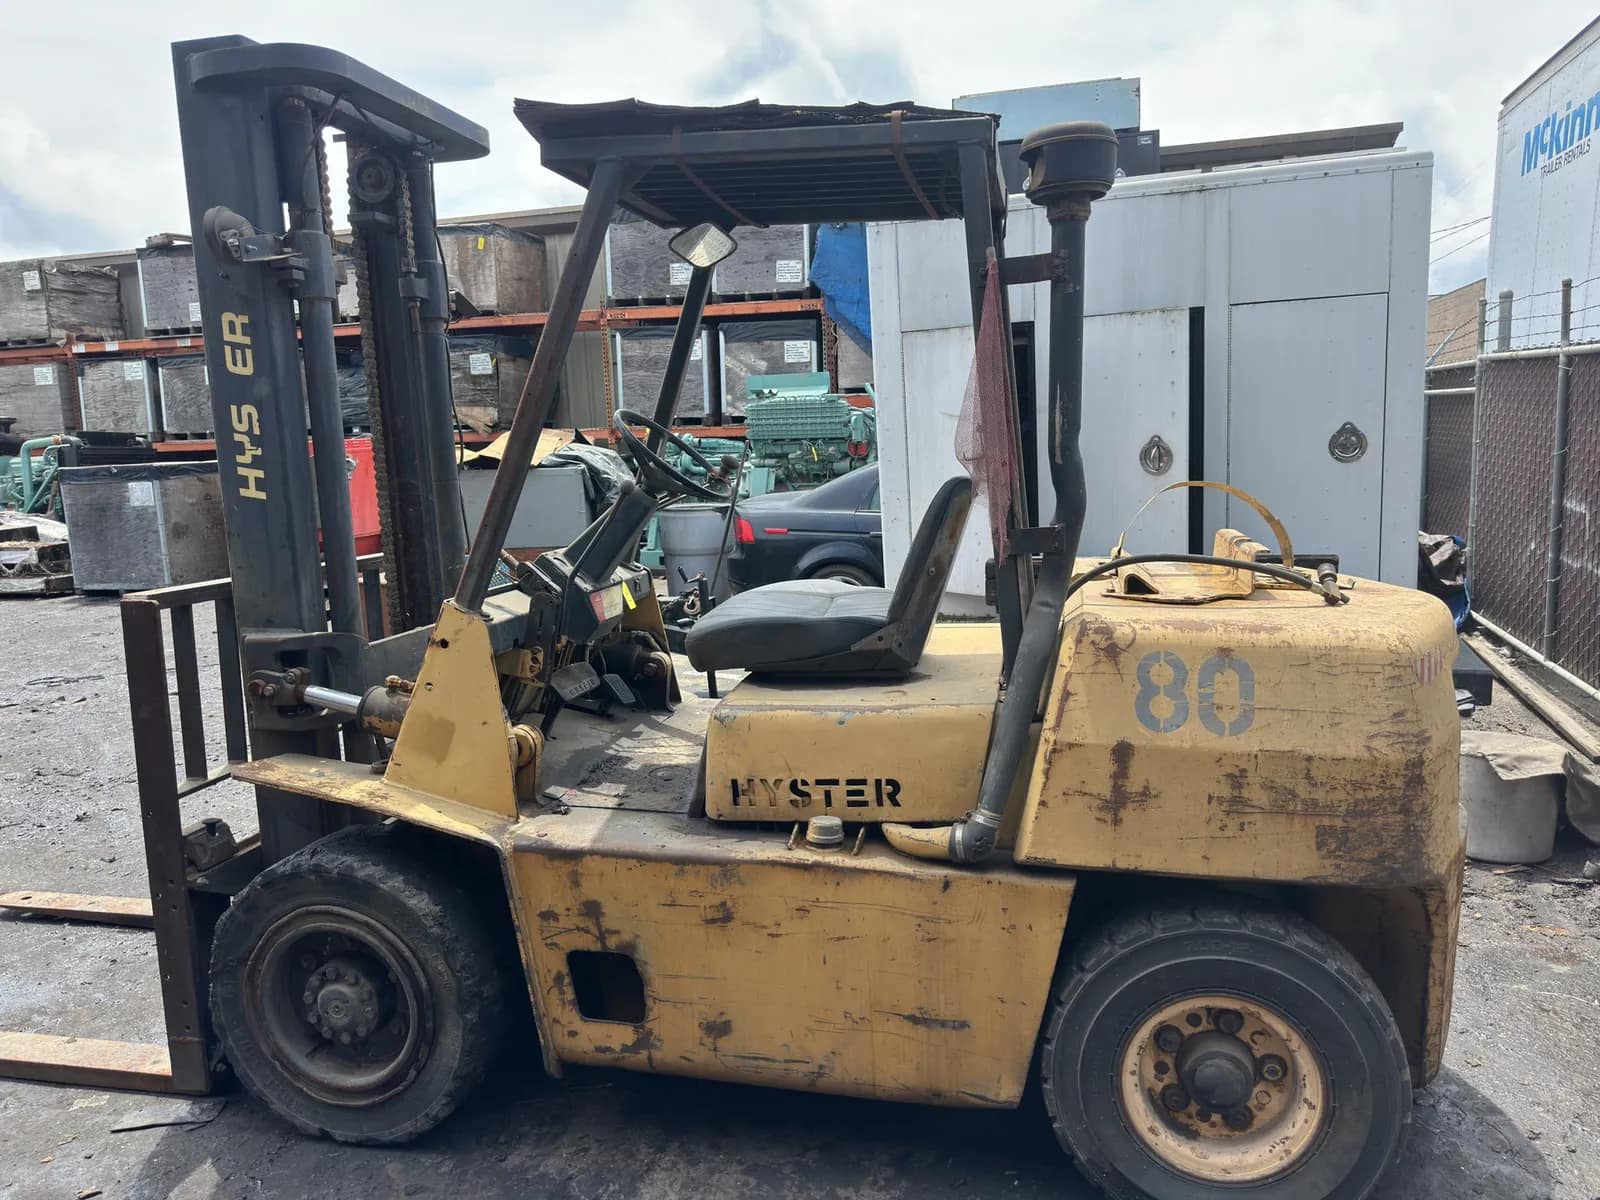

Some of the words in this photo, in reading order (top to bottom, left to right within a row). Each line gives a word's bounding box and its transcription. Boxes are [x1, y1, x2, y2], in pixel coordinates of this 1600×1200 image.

[1541, 155, 1563, 178] TRAILER
[1564, 138, 1591, 167] RENTALS
[1135, 651, 1255, 736] 80
[731, 778, 902, 808] HYSTER
